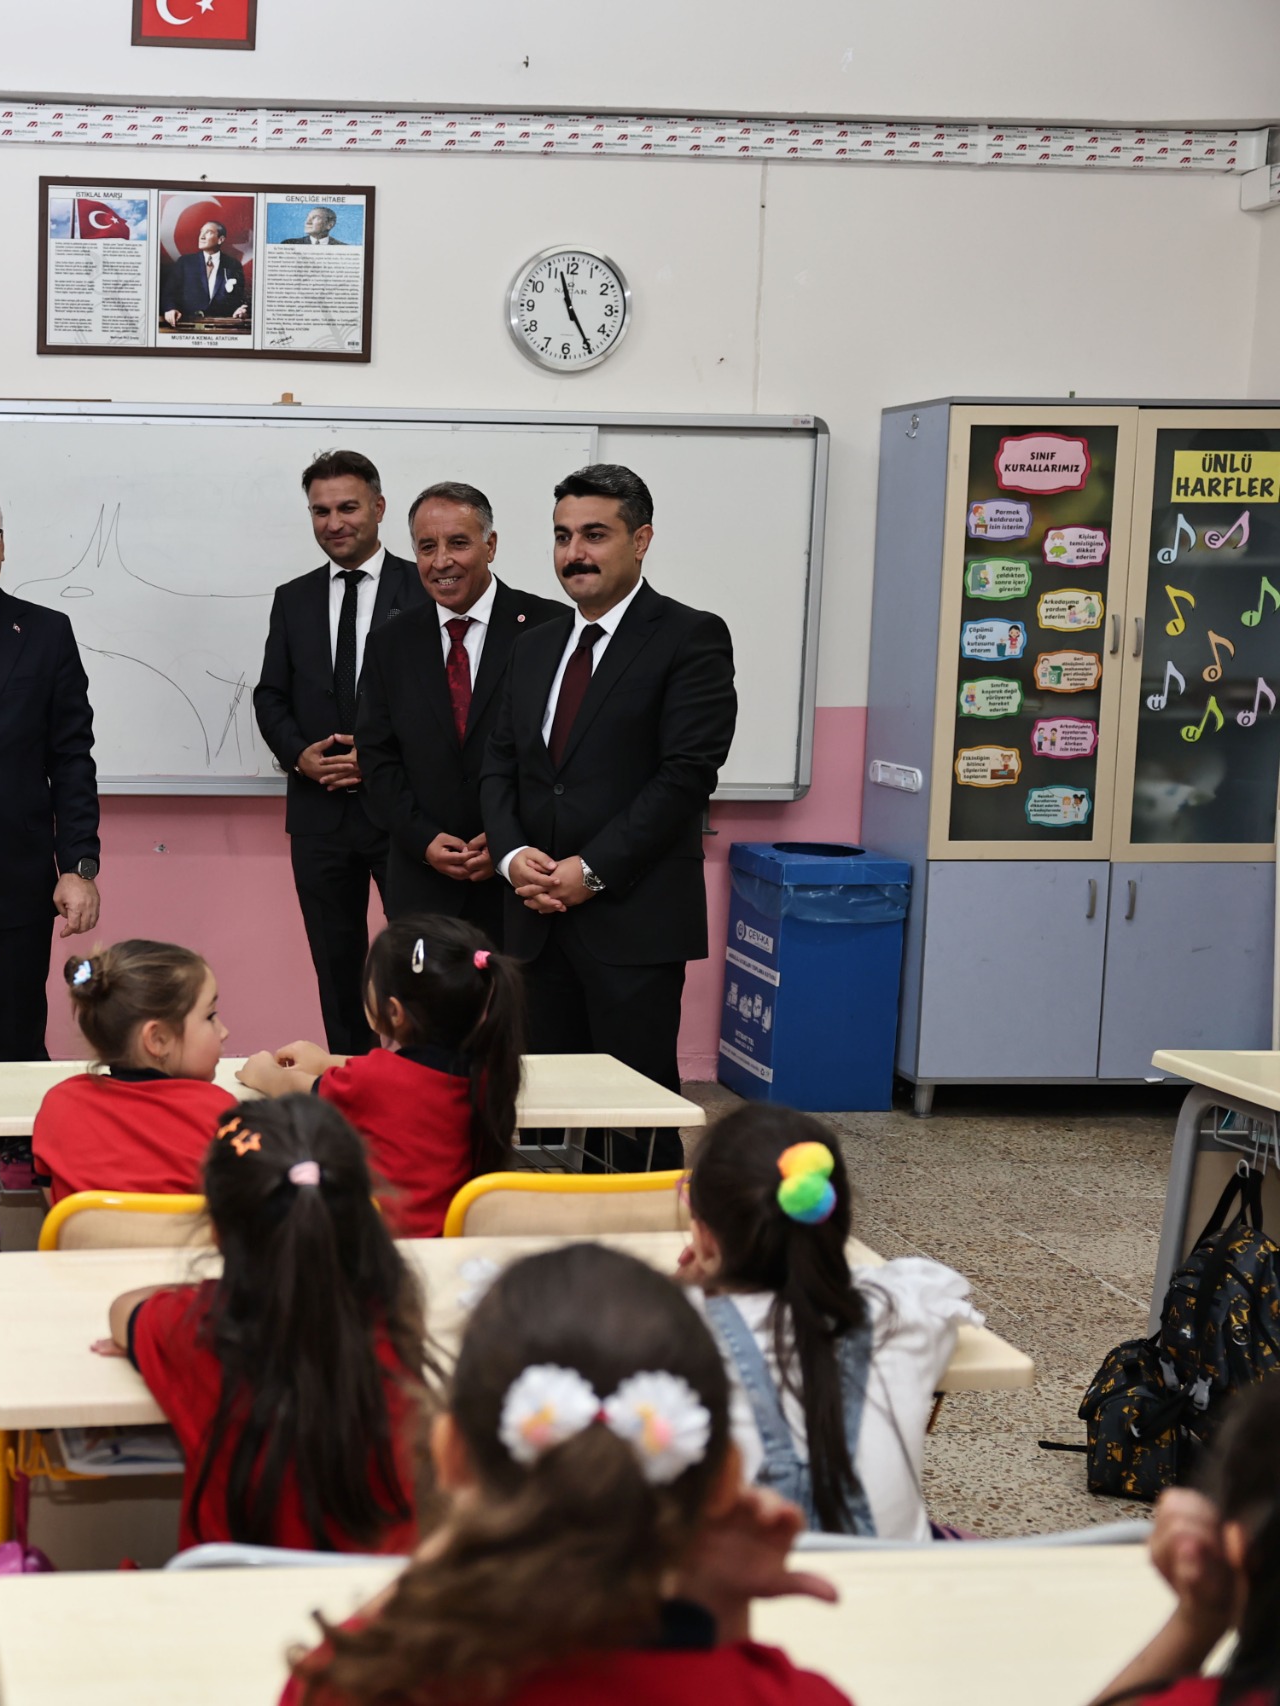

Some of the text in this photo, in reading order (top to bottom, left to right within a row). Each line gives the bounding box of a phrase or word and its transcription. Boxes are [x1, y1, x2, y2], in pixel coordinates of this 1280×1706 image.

[286, 195, 319, 203] GENÇLİĞE
[548, 267, 558, 279] 11
[566, 262, 579, 275] 12
[590, 267, 593, 278] 1
[532, 280, 544, 293] 10
[600, 283, 608, 296] 2
[526, 299, 535, 312] 9
[604, 304, 613, 317] 3
[528, 320, 538, 332] 8
[597, 324, 607, 335] 4
[544, 337, 552, 348] 7
[562, 343, 570, 354] 6
[1030, 452, 1056, 460] SINIF
[1004, 464, 1080, 472] KURALLARIMIZ
[1202, 453, 1252, 473] ÜNLÜ
[1175, 477, 1274, 497] HARFLER
[1208, 533, 1220, 546] e
[1162, 550, 1171, 562] a
[1208, 668, 1217, 679] o
[1152, 694, 1162, 710] ü
[1241, 710, 1251, 725] ö
[1186, 728, 1196, 740] u
